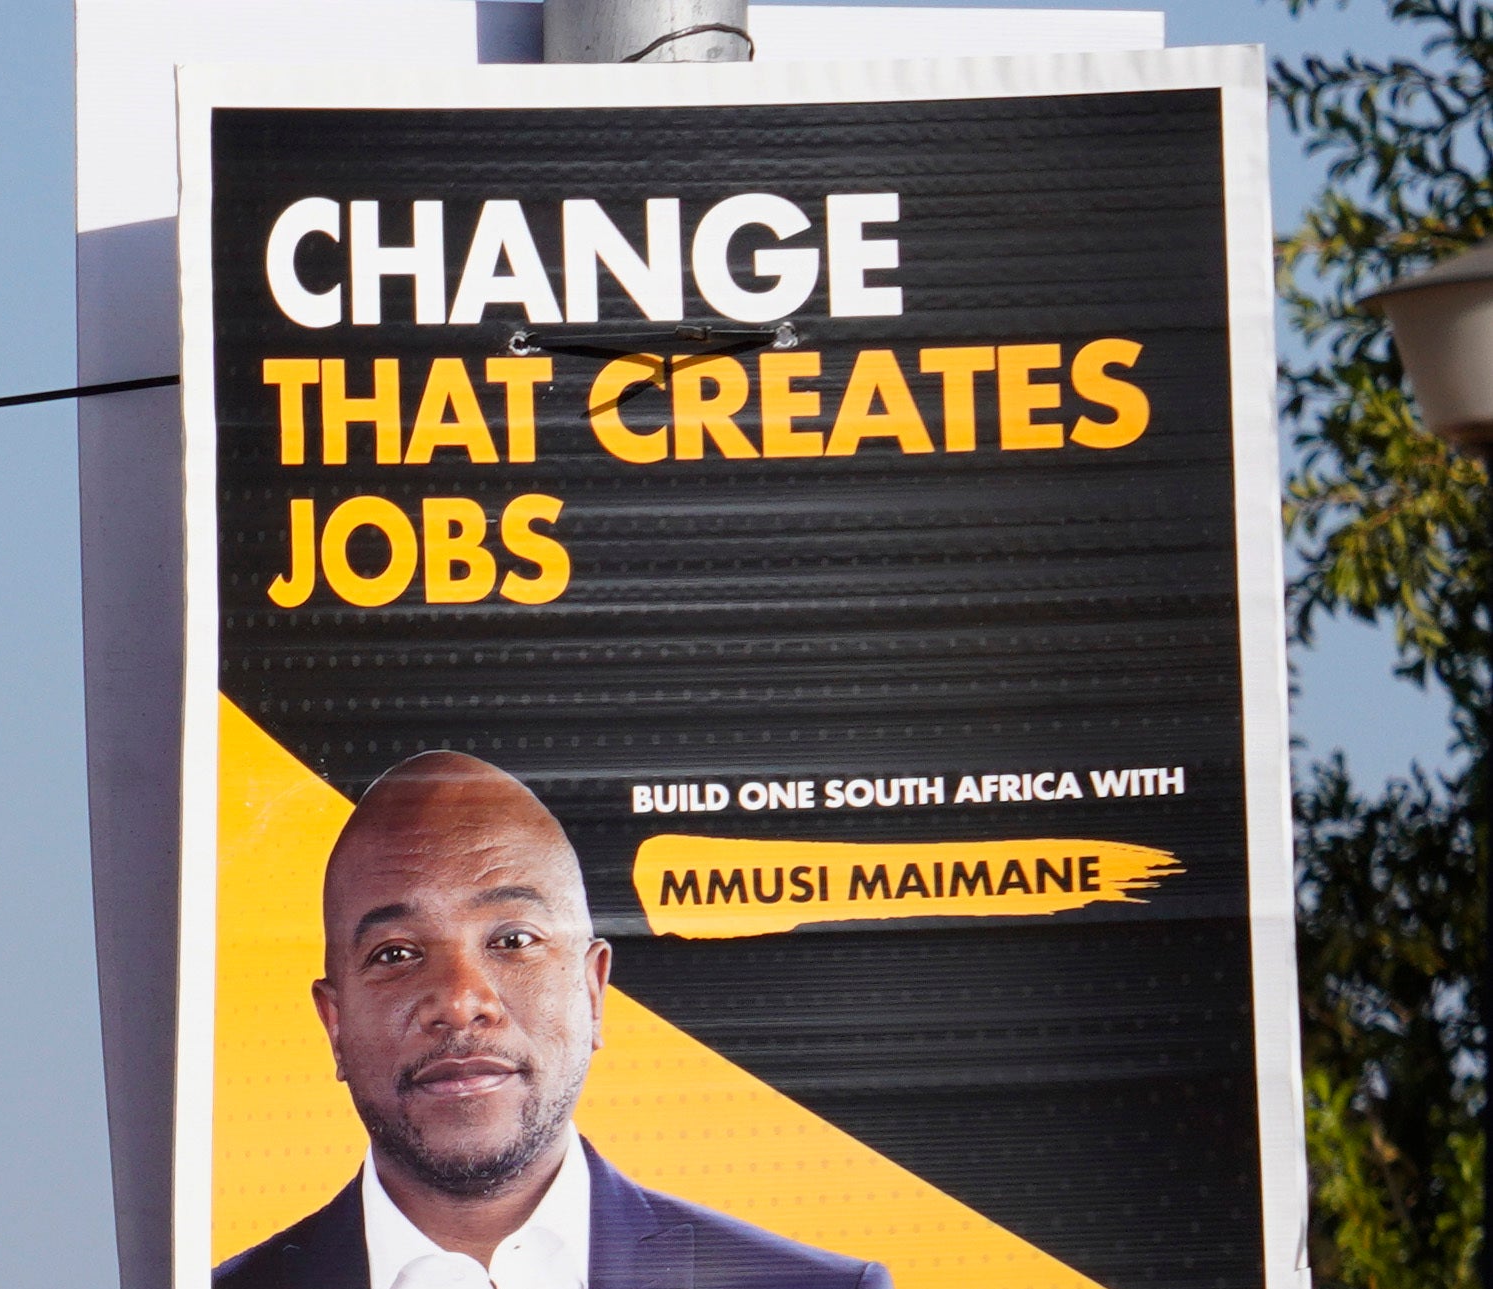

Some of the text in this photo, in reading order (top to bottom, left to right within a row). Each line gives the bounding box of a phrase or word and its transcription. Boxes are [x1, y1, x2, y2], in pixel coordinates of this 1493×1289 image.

[265, 191, 903, 328] CHANGE
[262, 338, 1152, 465] THAT CREATES
[267, 493, 571, 609] JOBS
[632, 764, 1185, 816] BUILD ONE SOUTH AFRICA WITH
[659, 853, 1102, 910] MMUSI MAIMANE
